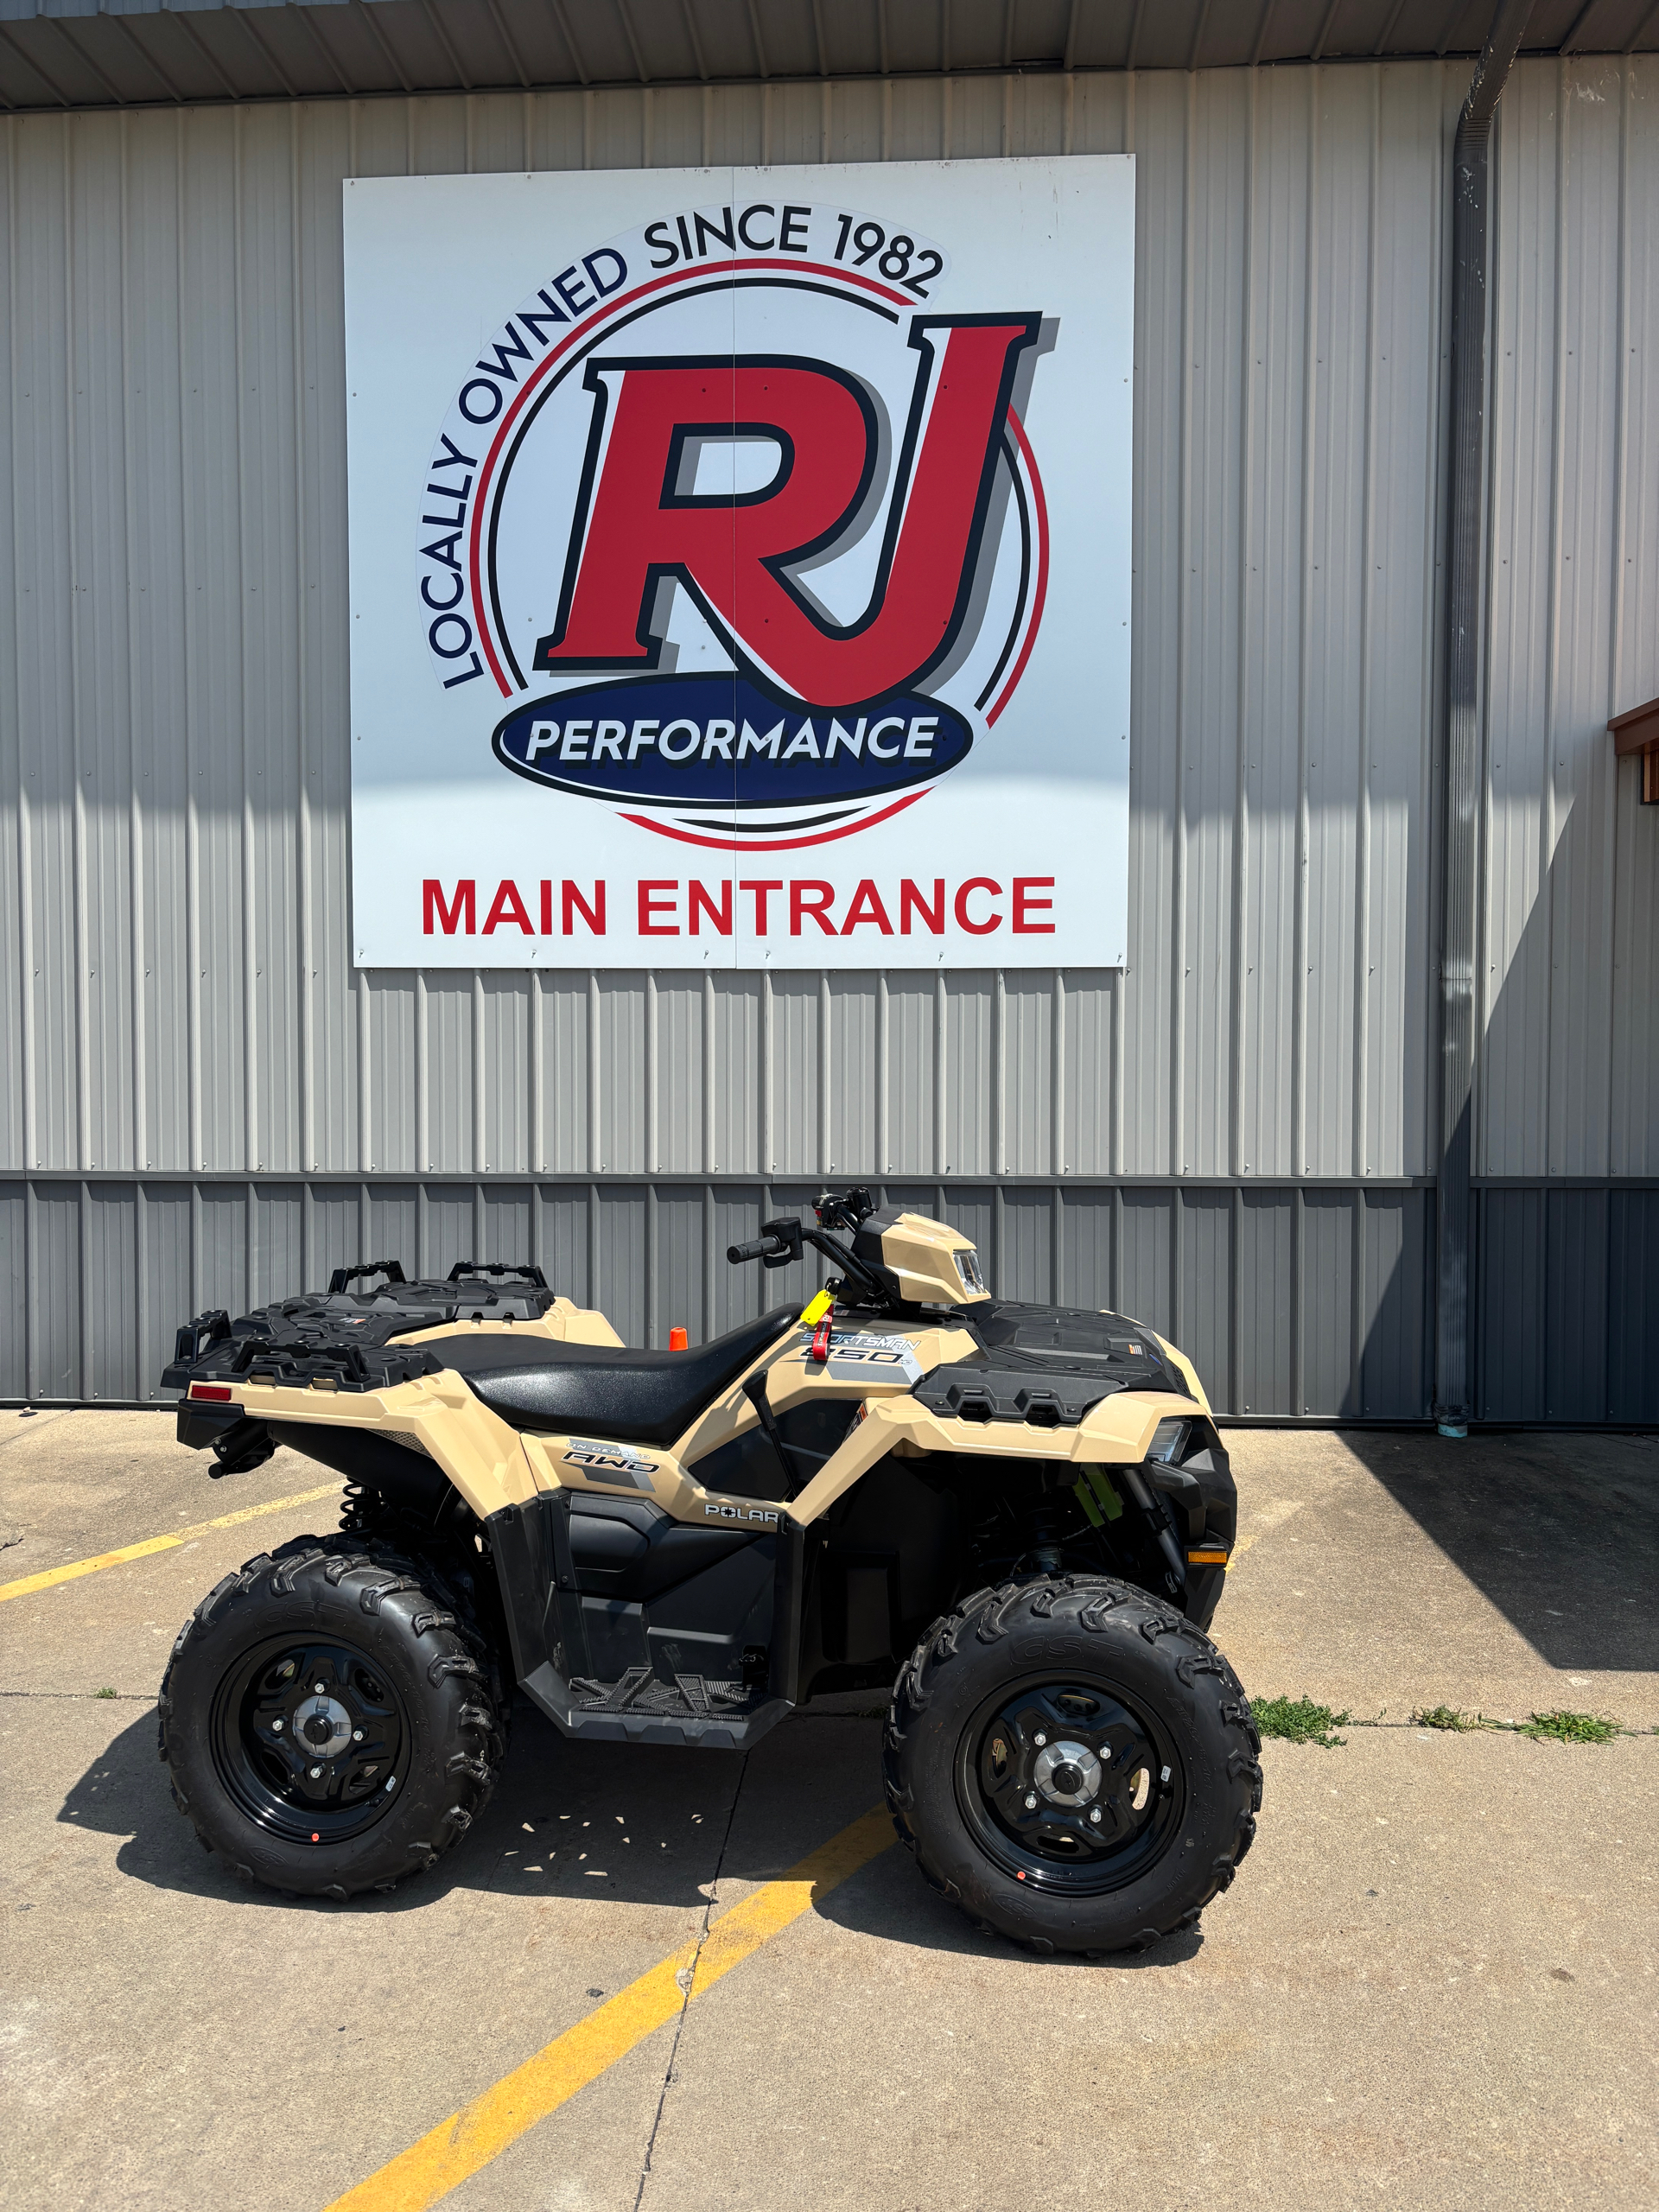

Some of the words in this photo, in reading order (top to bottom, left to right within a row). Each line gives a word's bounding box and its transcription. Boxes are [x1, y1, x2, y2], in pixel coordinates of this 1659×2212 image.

[418, 433, 485, 690] LOCALLY
[458, 248, 628, 425] OWNED
[644, 204, 812, 269] SINCE
[834, 213, 944, 299] 1982
[533, 311, 1046, 714] RJ
[524, 715, 940, 761] PERFORMANCE
[422, 879, 607, 937] MAIN
[637, 876, 1057, 938] ENTRANCE
[799, 1332, 921, 1351] SORTSMAN
[562, 1451, 660, 1474] AWD
[591, 1446, 651, 1459] DEMAND
[704, 1503, 779, 1523] POLAR
[1011, 1635, 1124, 1667] CST
